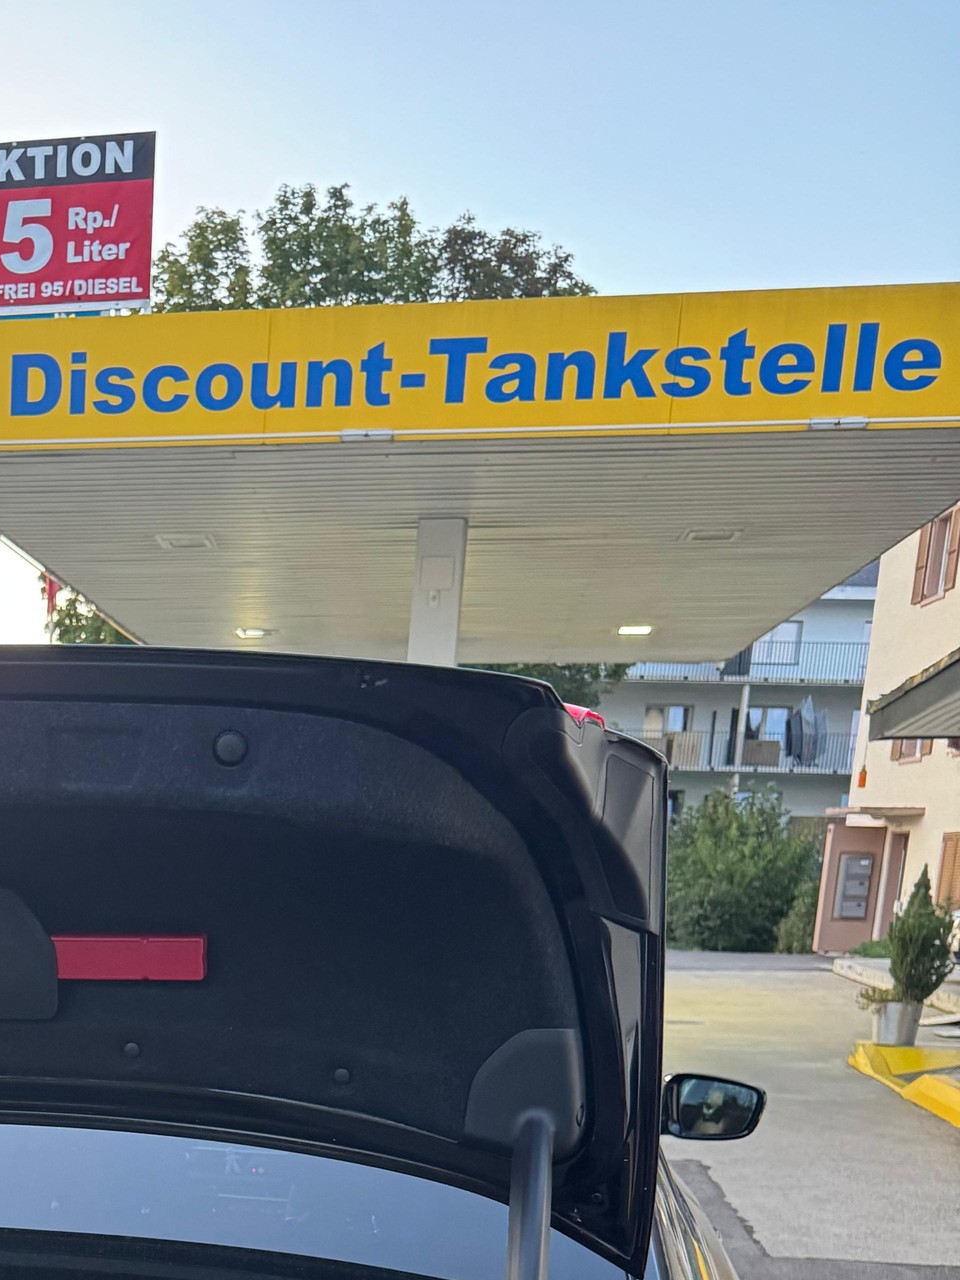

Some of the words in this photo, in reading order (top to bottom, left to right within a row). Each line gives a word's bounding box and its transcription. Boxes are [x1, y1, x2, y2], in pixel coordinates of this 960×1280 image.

[67, 203, 120, 234] Rp./
[66, 240, 131, 263] Liter
[9, 322, 942, 417] Discount-Tankstelle
